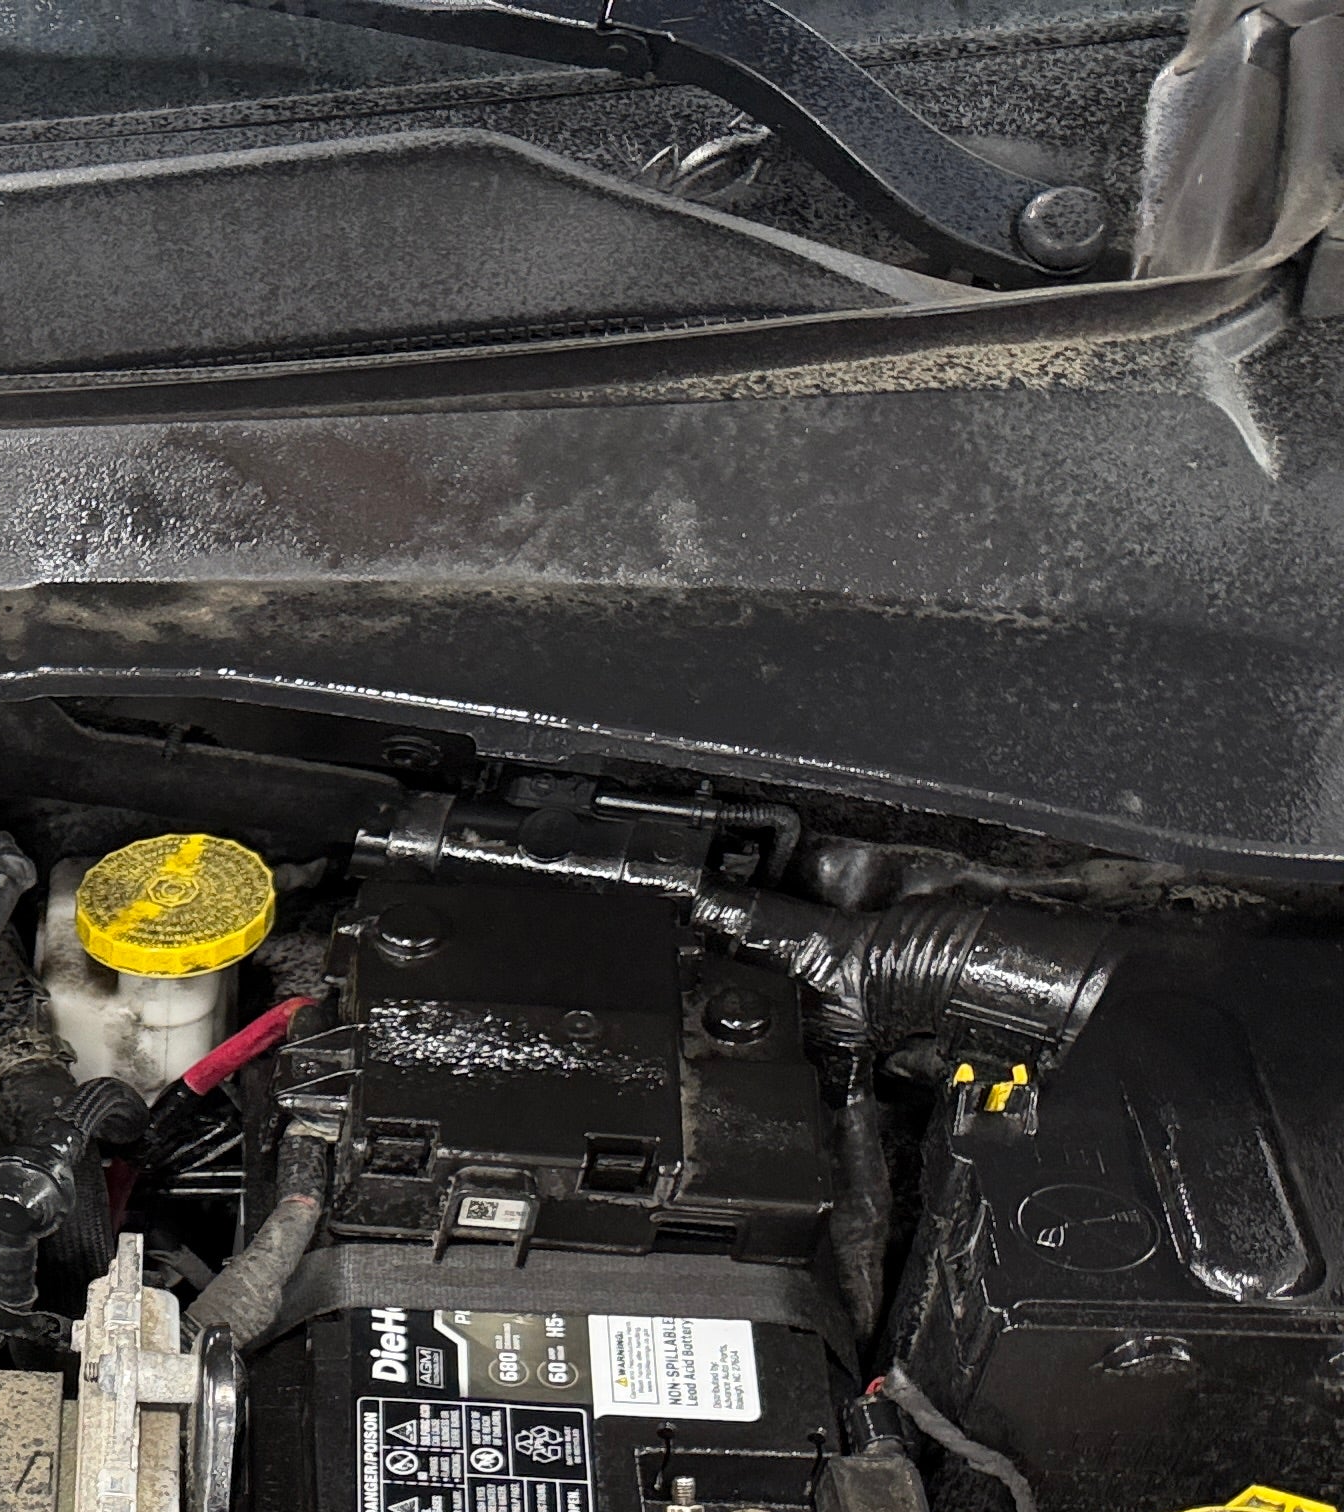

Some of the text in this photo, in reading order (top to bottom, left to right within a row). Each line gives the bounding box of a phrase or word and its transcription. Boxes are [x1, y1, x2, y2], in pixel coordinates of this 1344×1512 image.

[370, 1308, 408, 1383] DieH
[615, 1332, 625, 1375] WARNING:
[682, 1319, 698, 1406] Lead Acid Battery
[420, 1350, 432, 1384] AGM
[499, 1353, 518, 1381] 680
[548, 1363, 567, 1382] 60
[732, 1374, 740, 1382] NC
